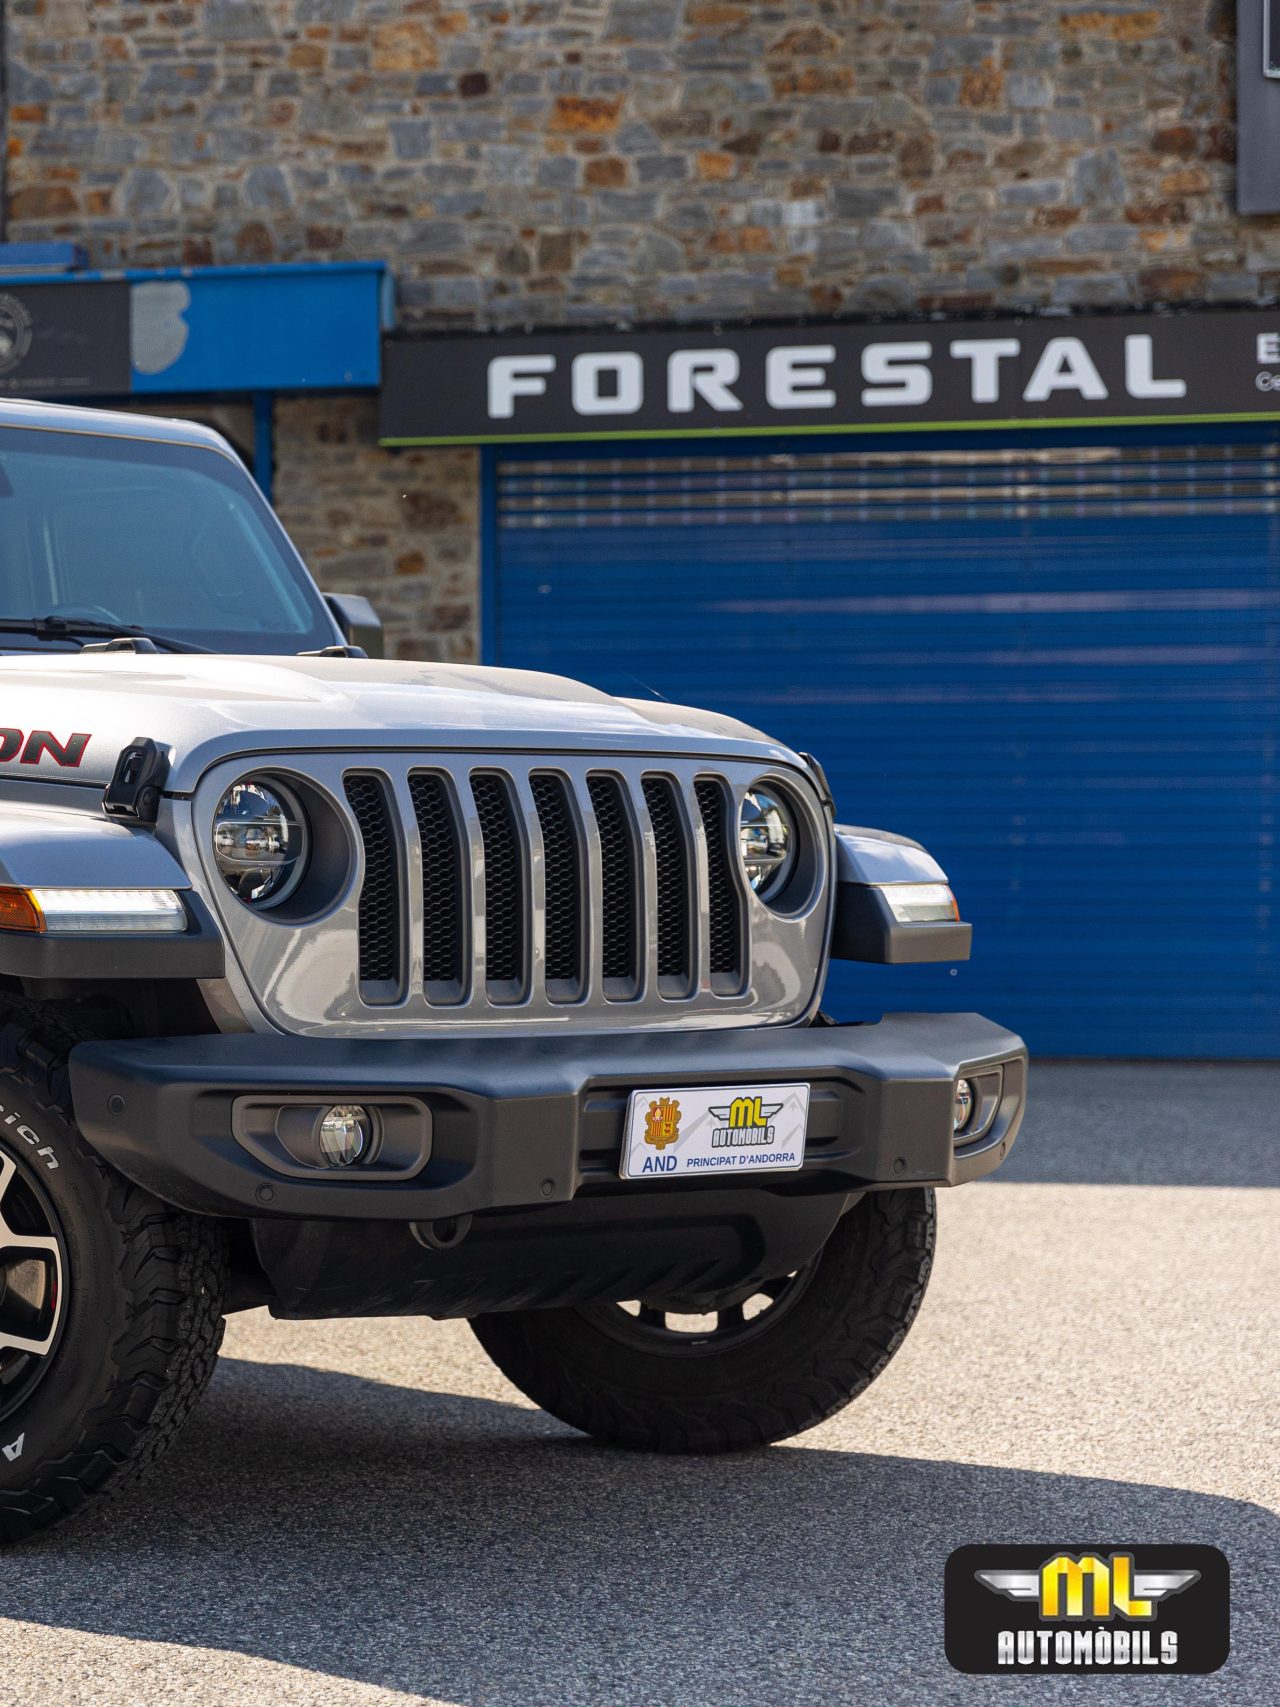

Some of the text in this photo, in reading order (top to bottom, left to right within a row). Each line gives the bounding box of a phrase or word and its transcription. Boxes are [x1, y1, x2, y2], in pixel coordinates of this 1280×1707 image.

[487, 334, 1186, 419] FORESTAL
[728, 1096, 769, 1128] ML
[642, 1152, 796, 1174] AND PRINCIPAT D'ANDORRA
